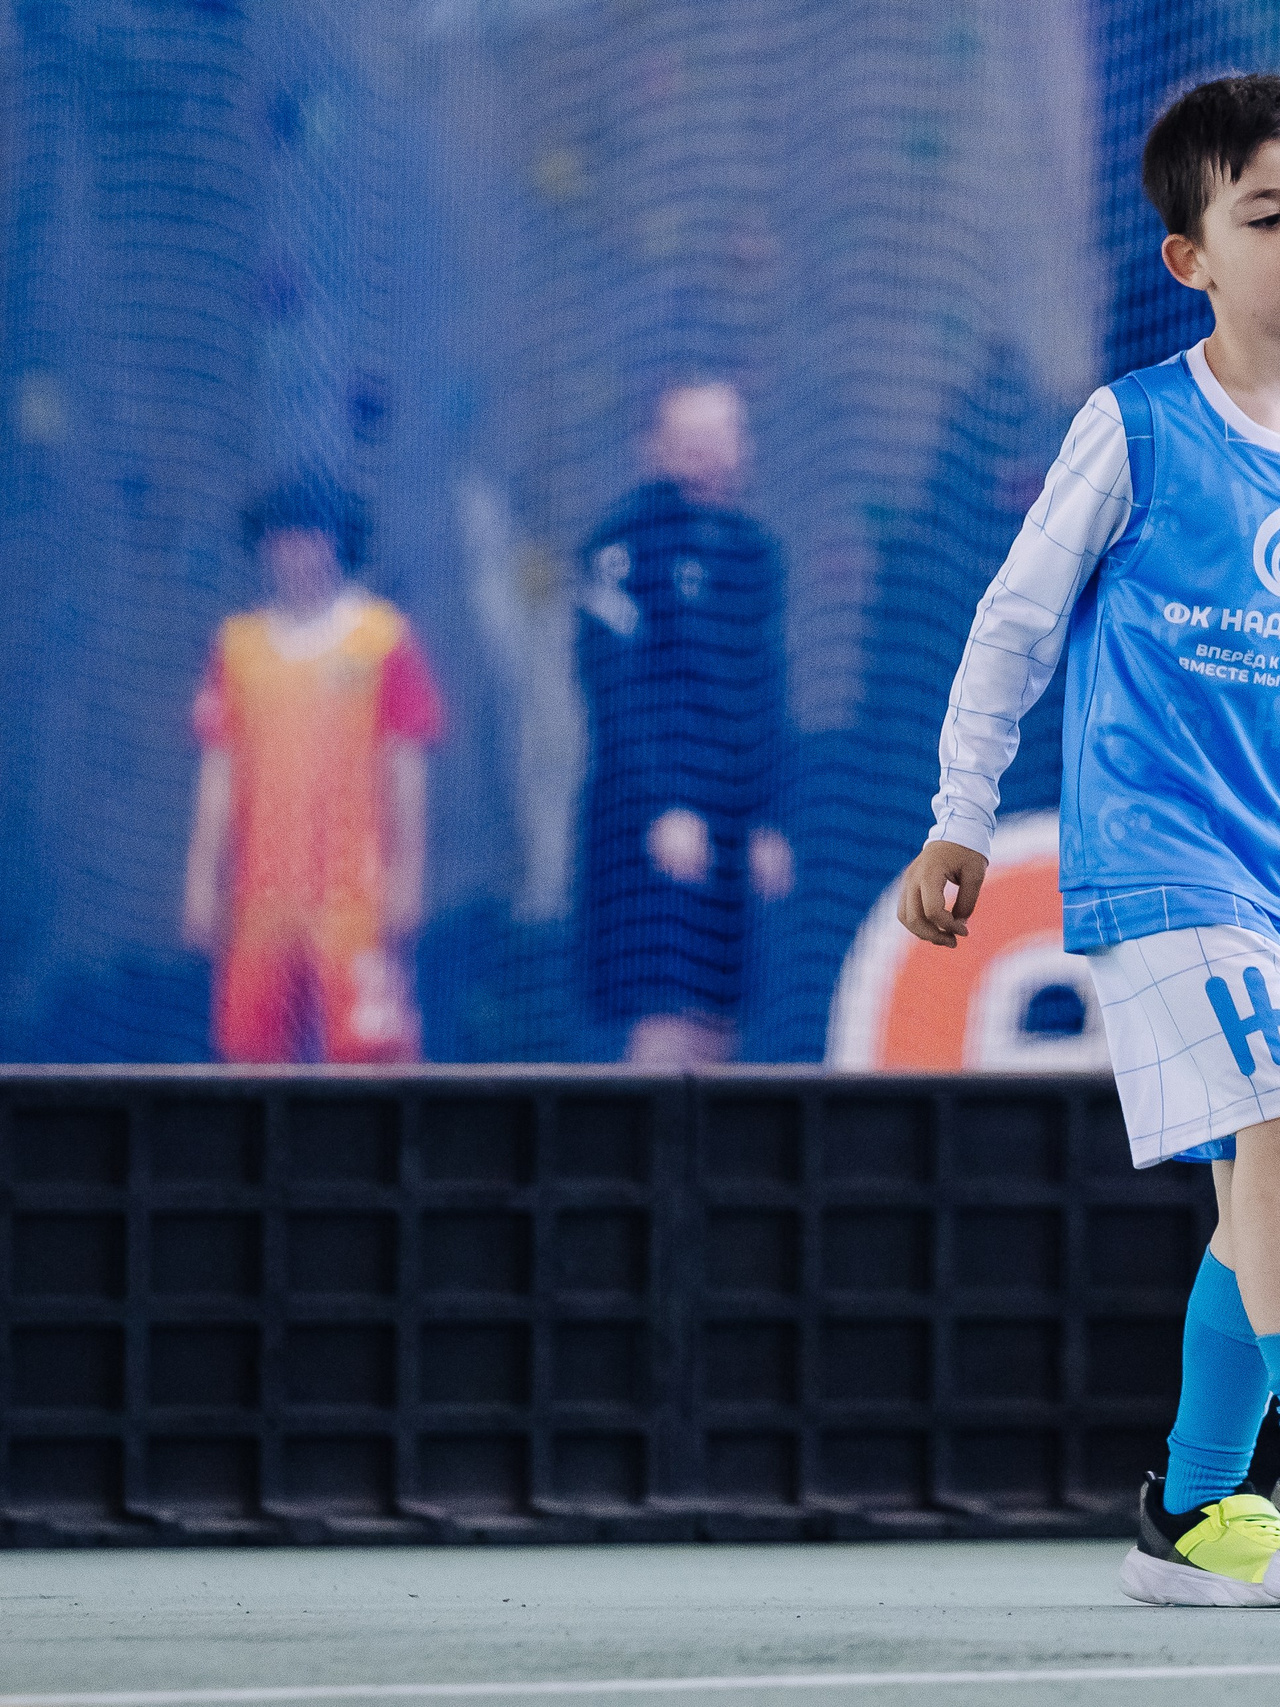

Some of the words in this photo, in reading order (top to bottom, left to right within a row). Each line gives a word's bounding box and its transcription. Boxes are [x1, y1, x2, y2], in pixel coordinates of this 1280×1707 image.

[1163, 602, 1212, 629] ФК
[1195, 643, 1266, 670] ВПЕРЁД
[1269, 655, 1280, 670] К
[1253, 671, 1280, 688] МЫ
